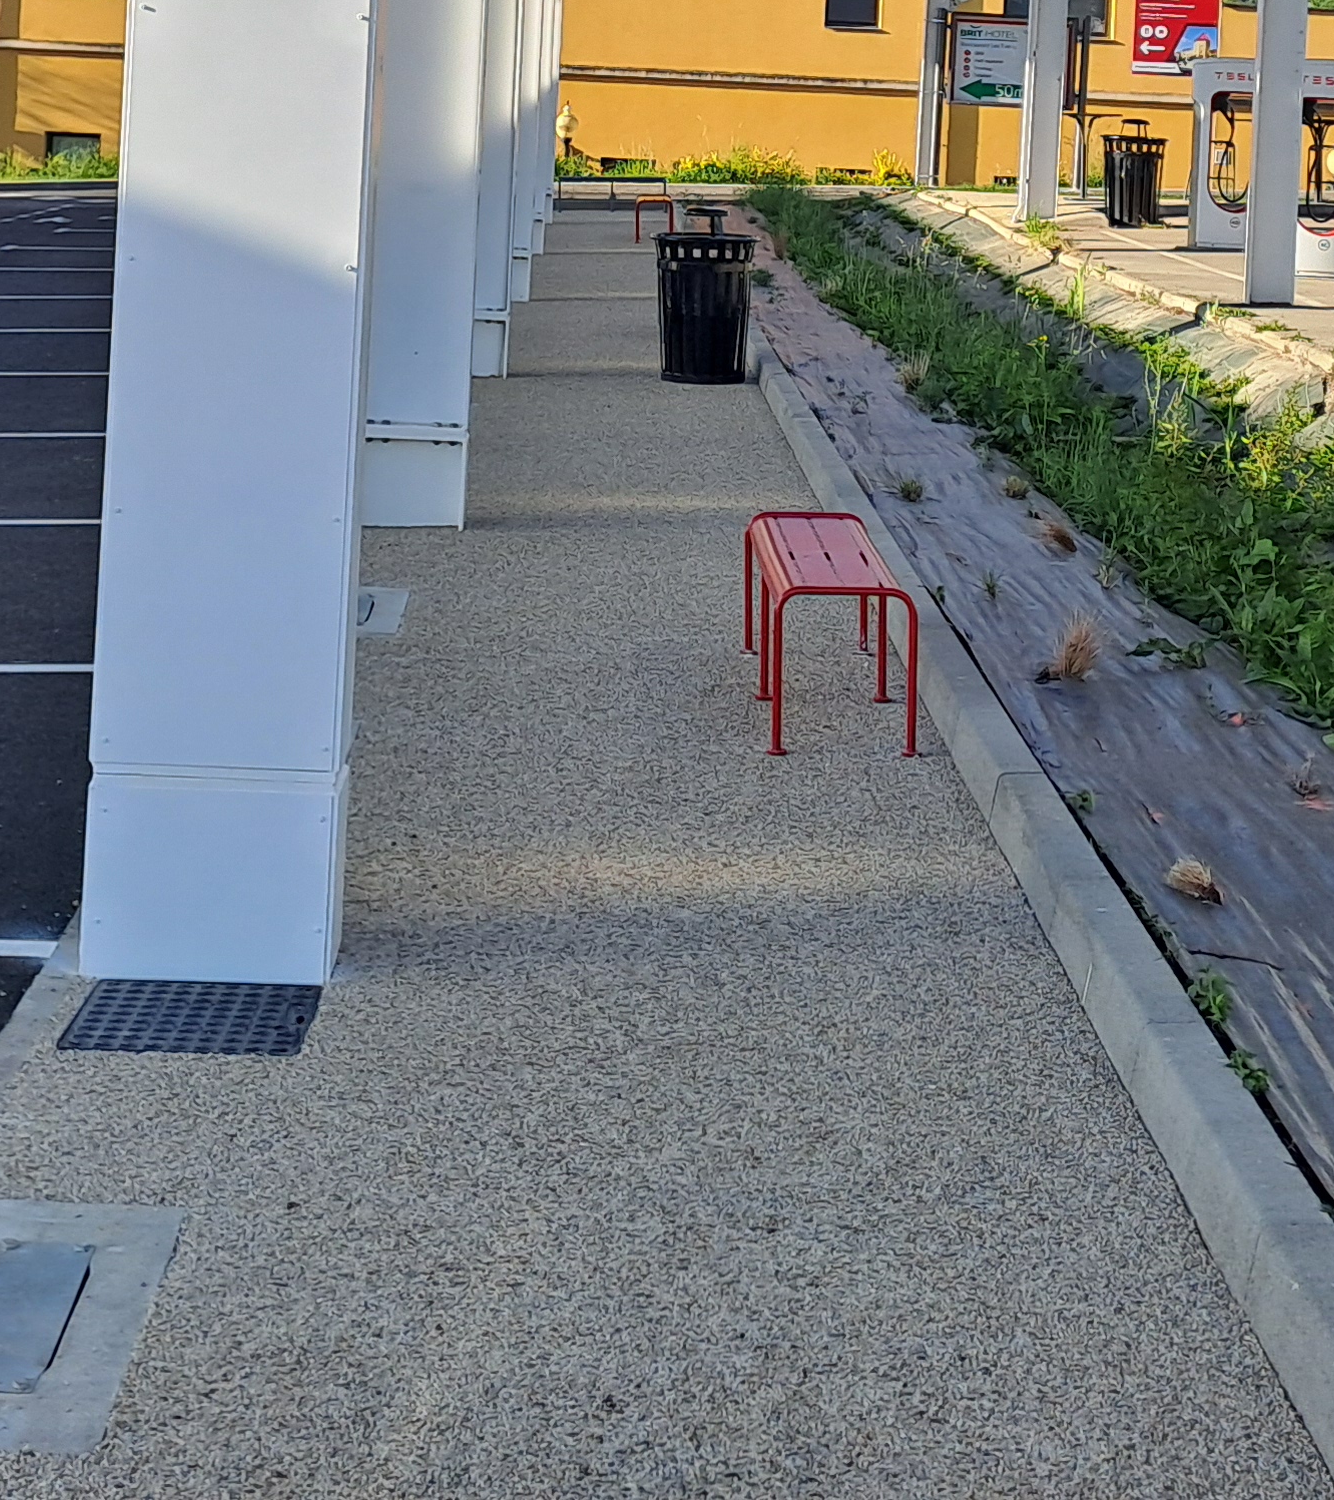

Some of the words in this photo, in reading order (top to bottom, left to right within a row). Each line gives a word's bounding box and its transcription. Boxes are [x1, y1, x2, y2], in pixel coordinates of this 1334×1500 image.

[960, 29, 983, 37] BRIT
[985, 30, 1018, 39] HOTEL
[1214, 71, 1255, 81] TESL
